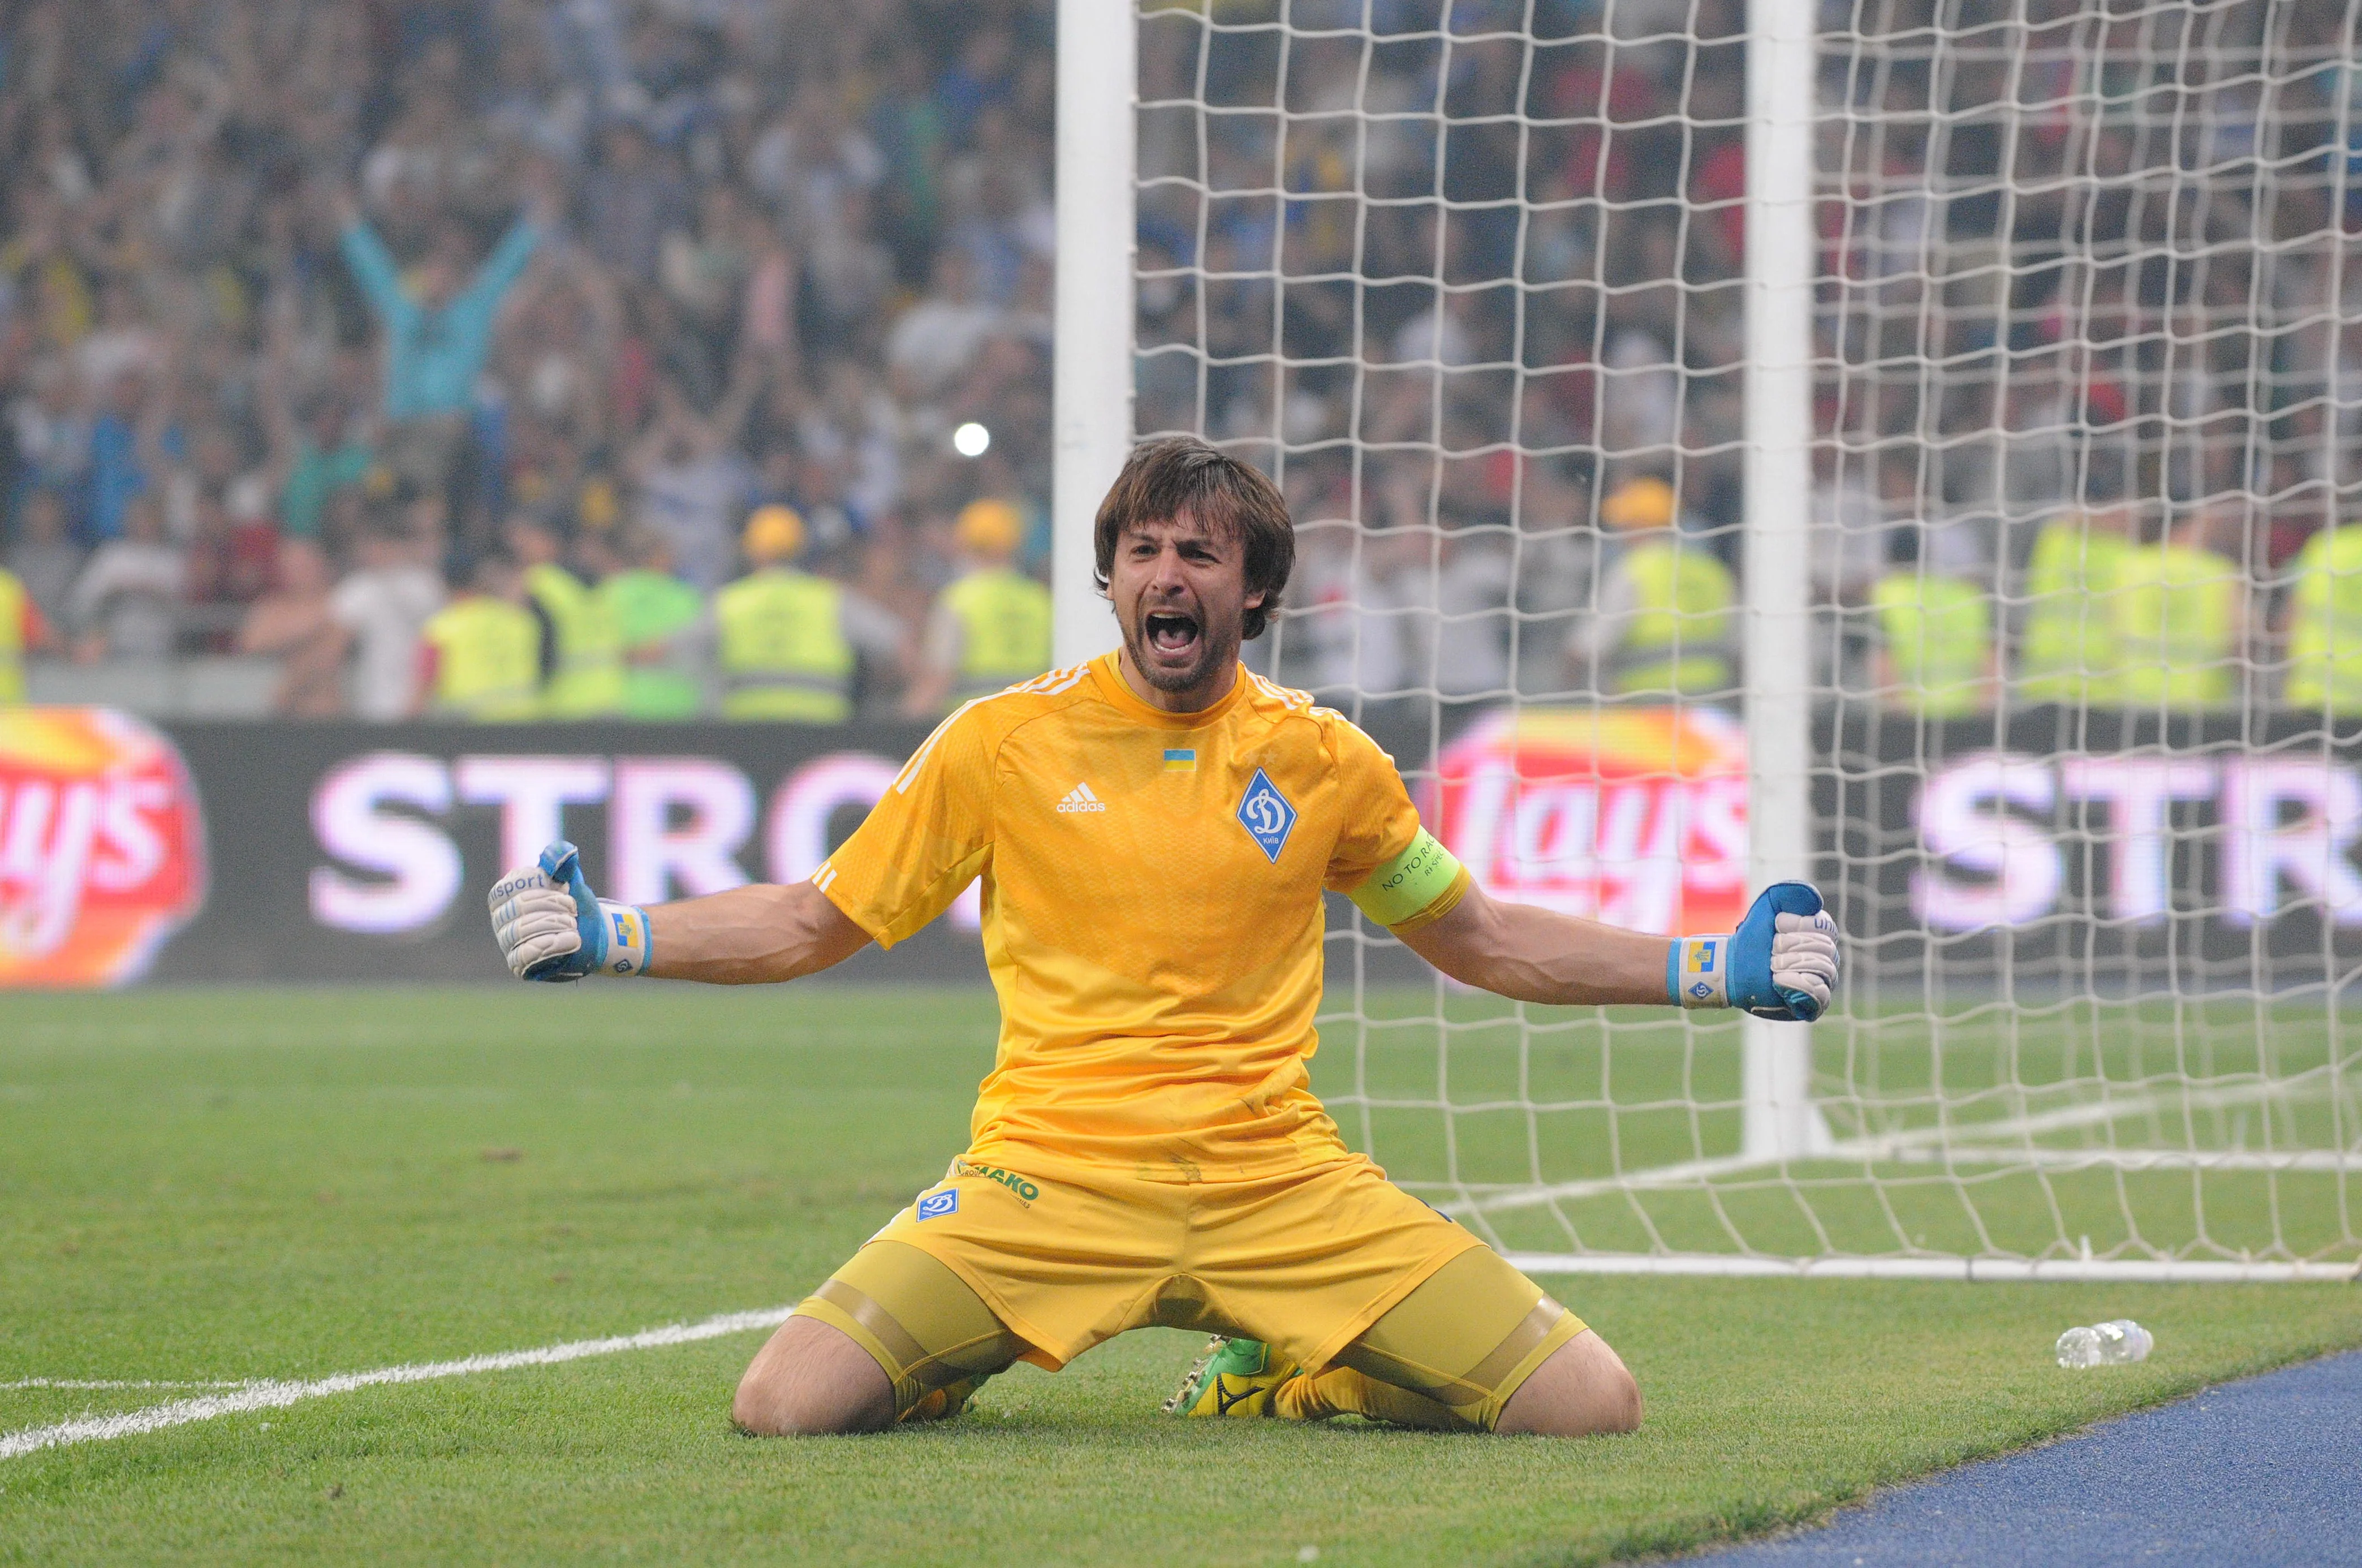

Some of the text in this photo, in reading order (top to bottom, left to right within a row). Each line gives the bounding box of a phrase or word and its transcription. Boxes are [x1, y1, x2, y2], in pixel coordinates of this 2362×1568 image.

[1056, 800, 1105, 812] adidas
[308, 751, 983, 933] STRO
[1382, 873, 1403, 891] NO
[1404, 857, 1421, 874] TO
